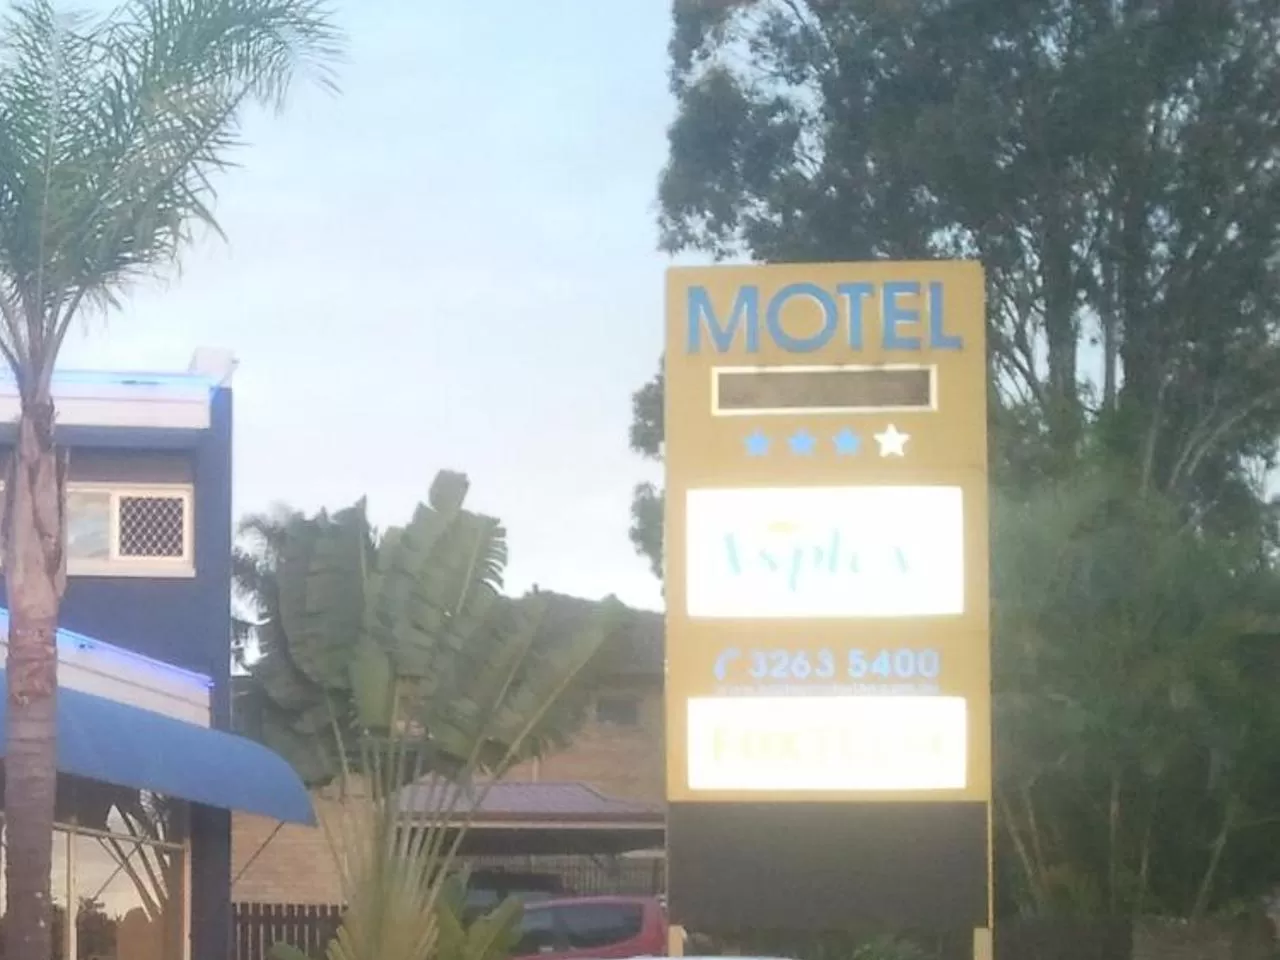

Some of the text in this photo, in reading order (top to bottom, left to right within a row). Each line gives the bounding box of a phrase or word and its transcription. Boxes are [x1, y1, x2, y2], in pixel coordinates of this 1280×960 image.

[686, 281, 963, 354] MOTEL
[749, 647, 942, 680] 3263 5400
